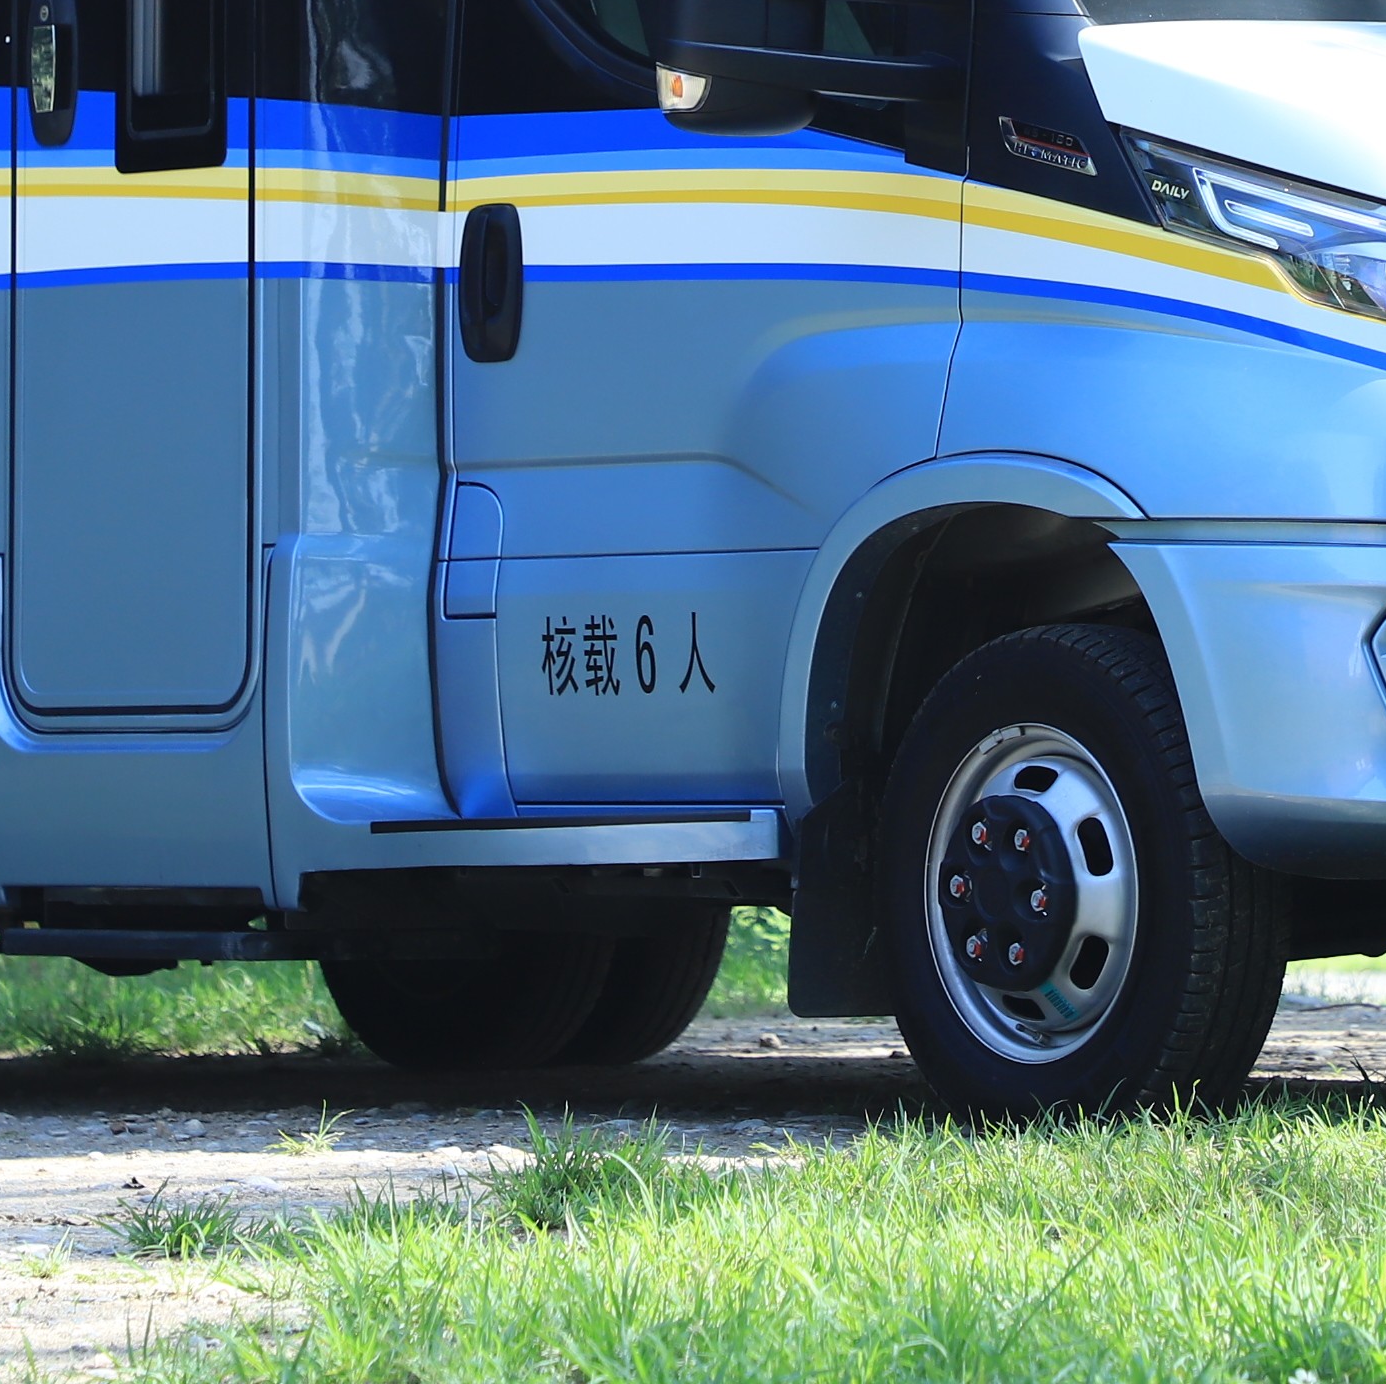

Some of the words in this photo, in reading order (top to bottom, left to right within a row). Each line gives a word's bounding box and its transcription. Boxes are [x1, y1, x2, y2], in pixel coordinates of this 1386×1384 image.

[1150, 178, 1190, 200] DAILY
[541, 614, 621, 697] 核载
[635, 613, 657, 695] 6
[678, 611, 717, 694] 人
